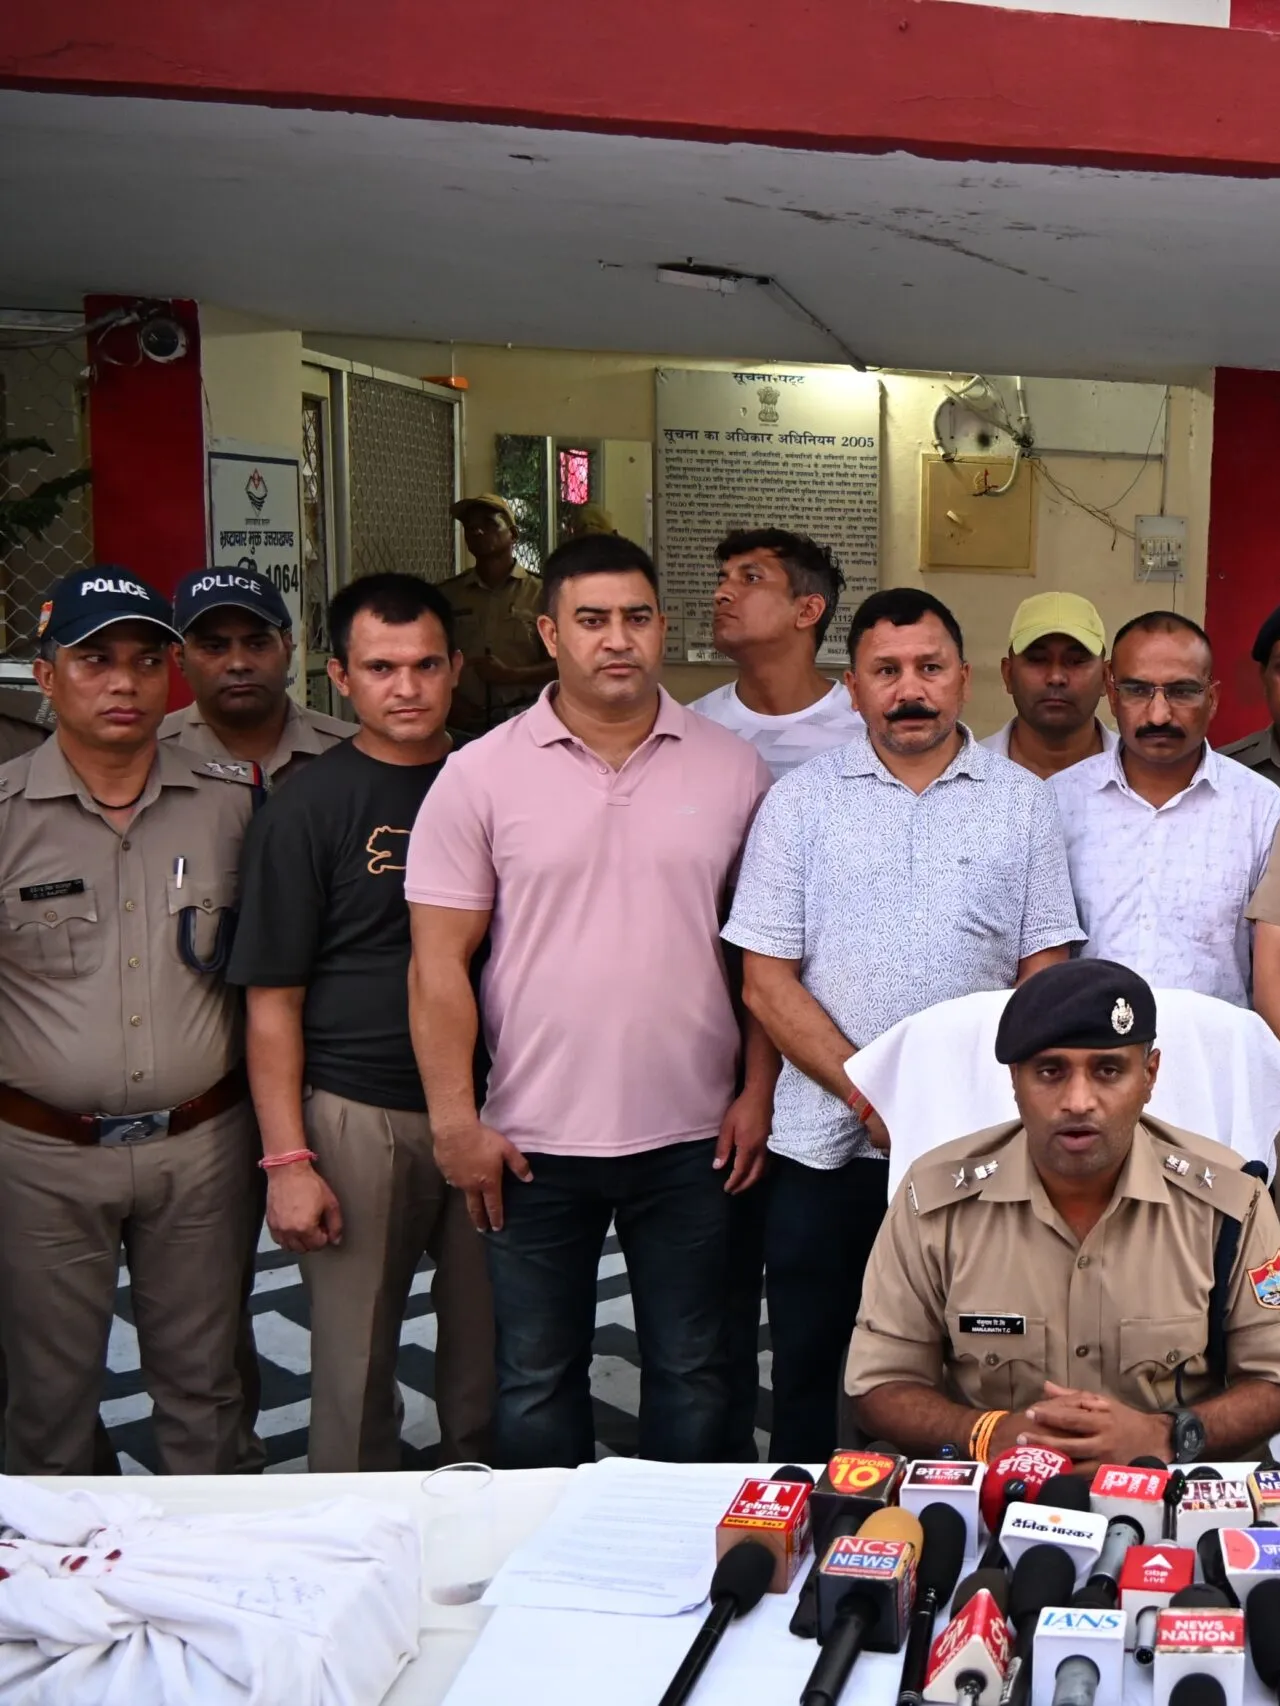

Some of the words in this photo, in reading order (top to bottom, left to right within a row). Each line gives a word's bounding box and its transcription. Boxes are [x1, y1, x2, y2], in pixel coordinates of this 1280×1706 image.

[663, 429, 699, 444] सूचना
[704, 430, 719, 441] का
[725, 428, 773, 444] अधिकार
[778, 430, 836, 446] अधिनियम
[841, 436, 875, 448] 2005
[81, 578, 150, 600] POLICE
[192, 575, 263, 596] POLICE
[831, 1455, 894, 1468] NETWORK
[832, 1464, 881, 1488] 10
[915, 1467, 973, 1477] भारत
[756, 1483, 792, 1503] T
[739, 1500, 791, 1512] Tehelka
[1011, 1518, 1049, 1532] दैनिक
[838, 1538, 901, 1556] NCS
[832, 1553, 896, 1569] NEWS
[1143, 1576, 1166, 1584] LIVE
[1144, 1569, 1169, 1577] abp
[1042, 1612, 1122, 1629] IANS
[1174, 1620, 1225, 1630] NEWS
[1160, 1629, 1236, 1642] NATION
